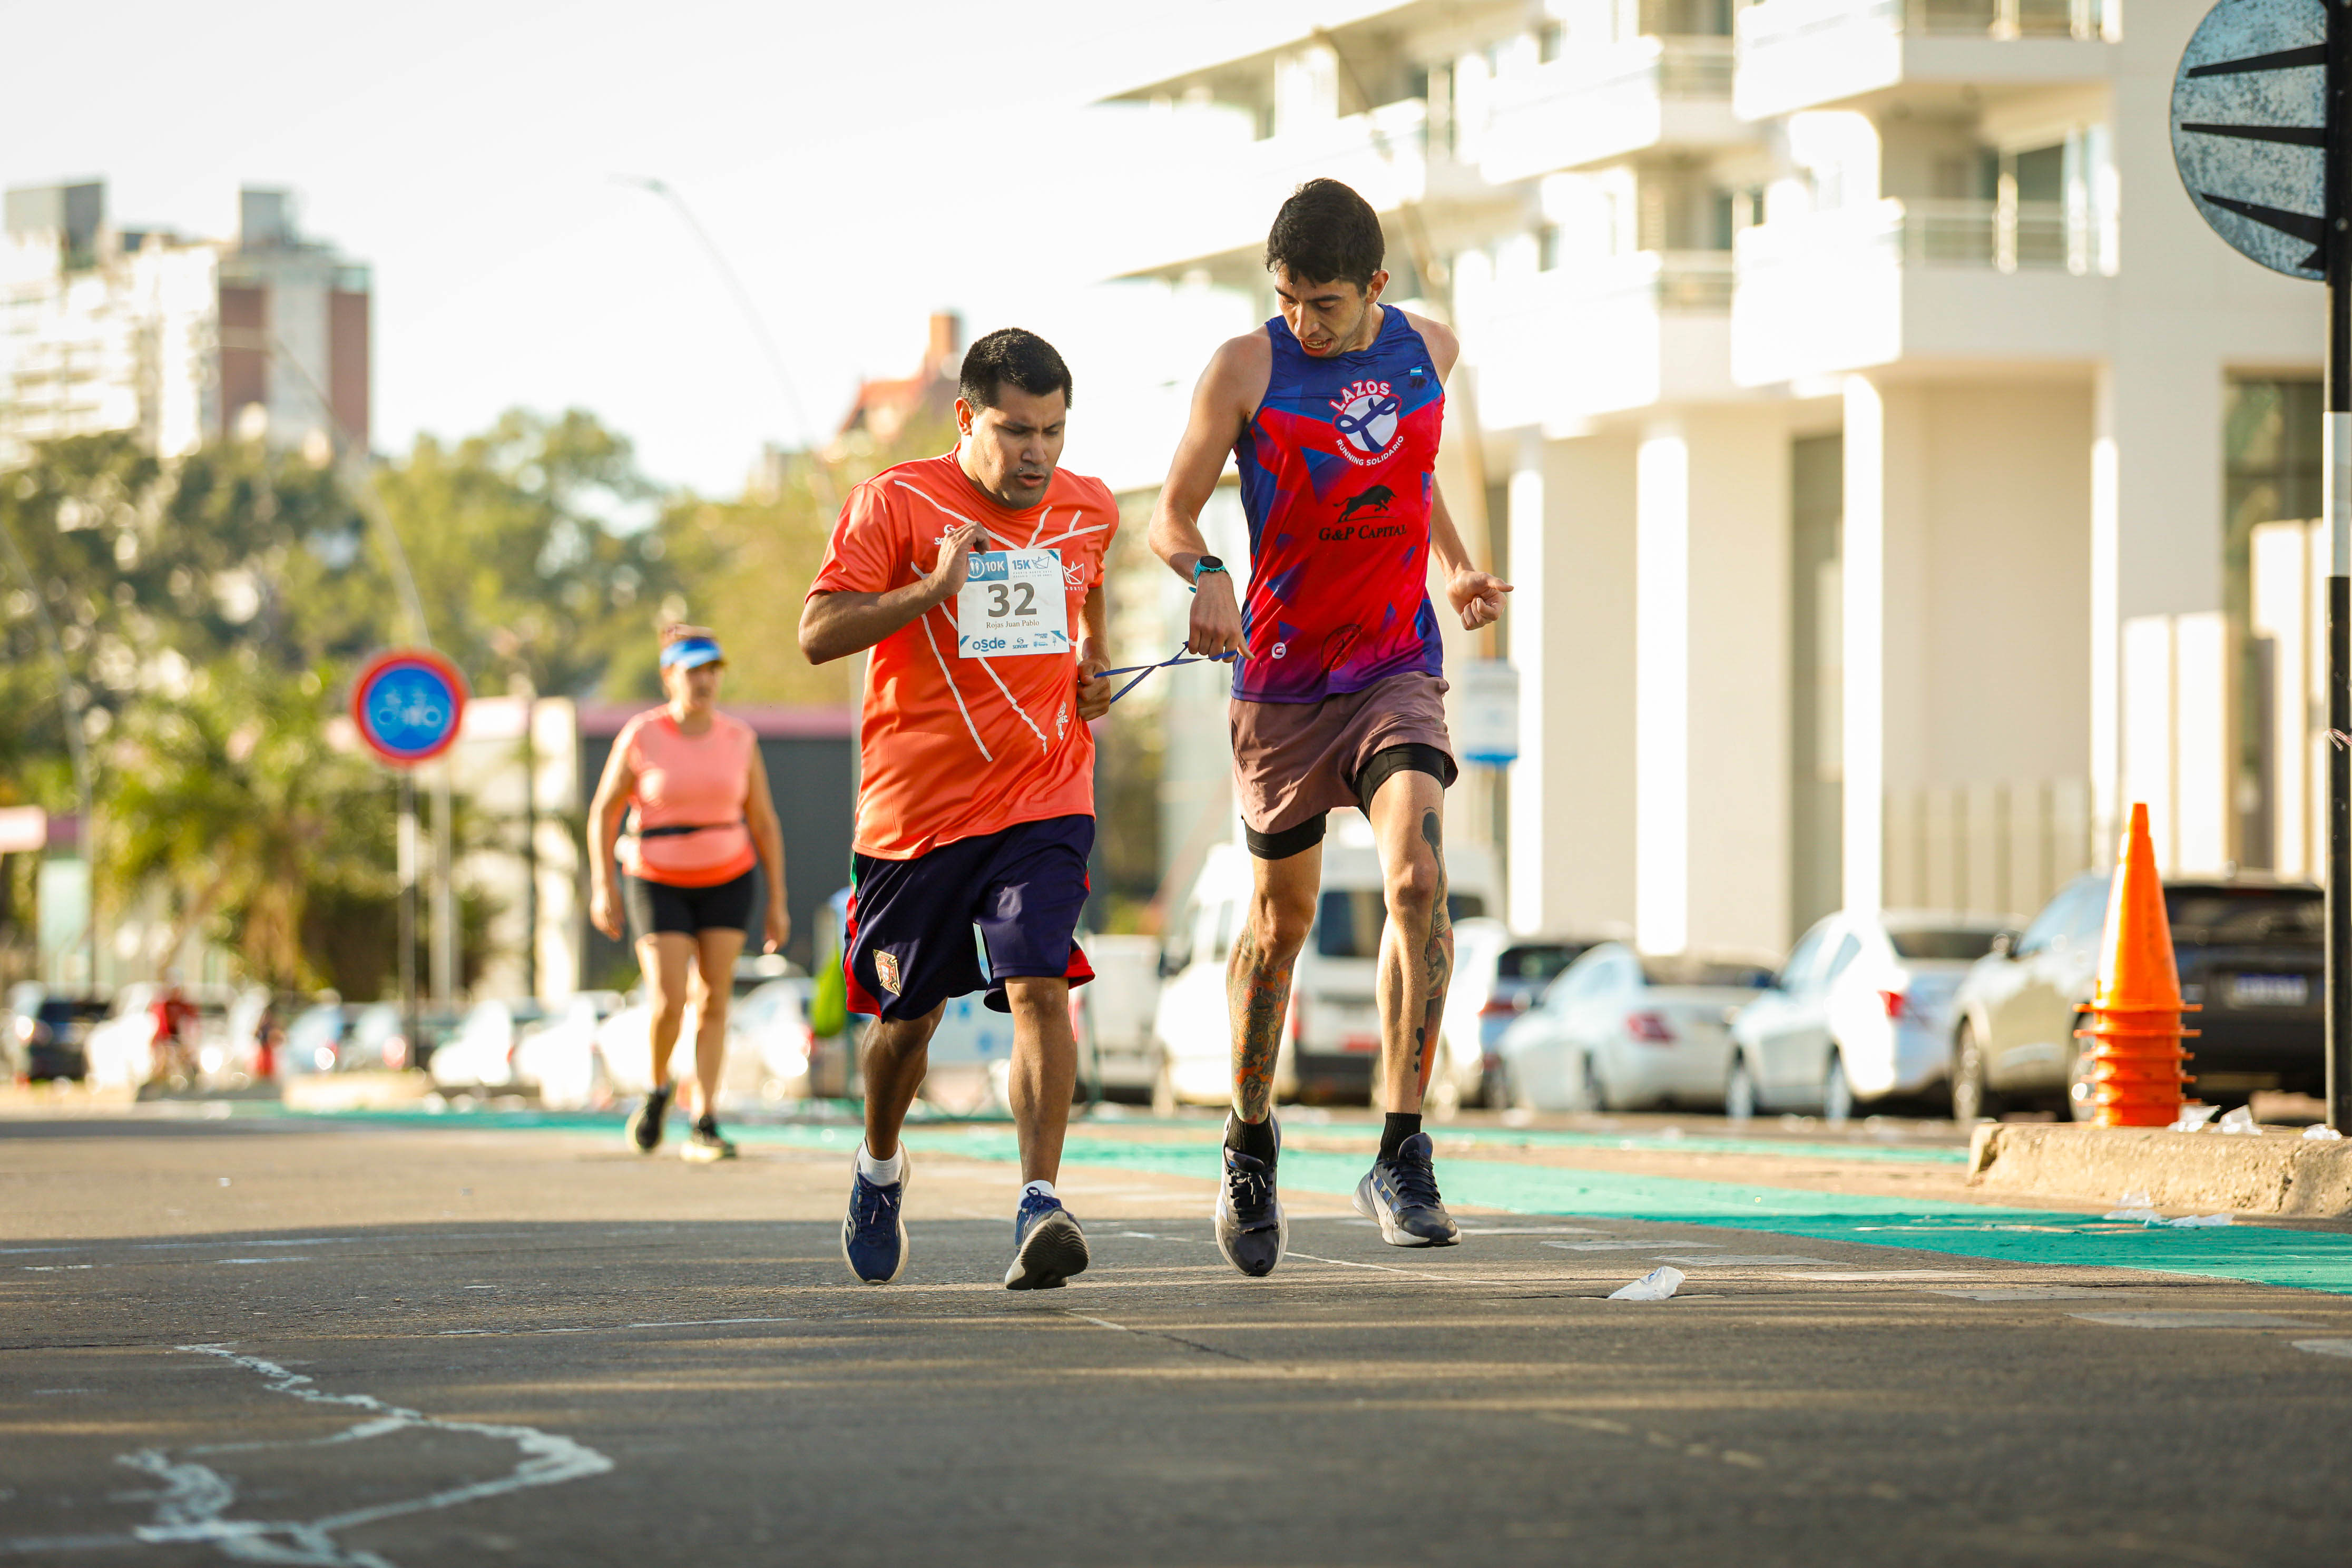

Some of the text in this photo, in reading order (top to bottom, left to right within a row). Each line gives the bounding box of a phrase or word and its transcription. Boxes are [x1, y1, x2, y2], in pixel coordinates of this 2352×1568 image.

[1330, 380, 1390, 411] LAZOS
[1336, 436, 1404, 466] RUNNING SOLIDARIO
[1319, 527, 1355, 541] G&P
[985, 561, 1005, 572] 10K
[1012, 559, 1031, 570] 15K
[987, 582, 1037, 618] 32
[972, 636, 1006, 650] osde
